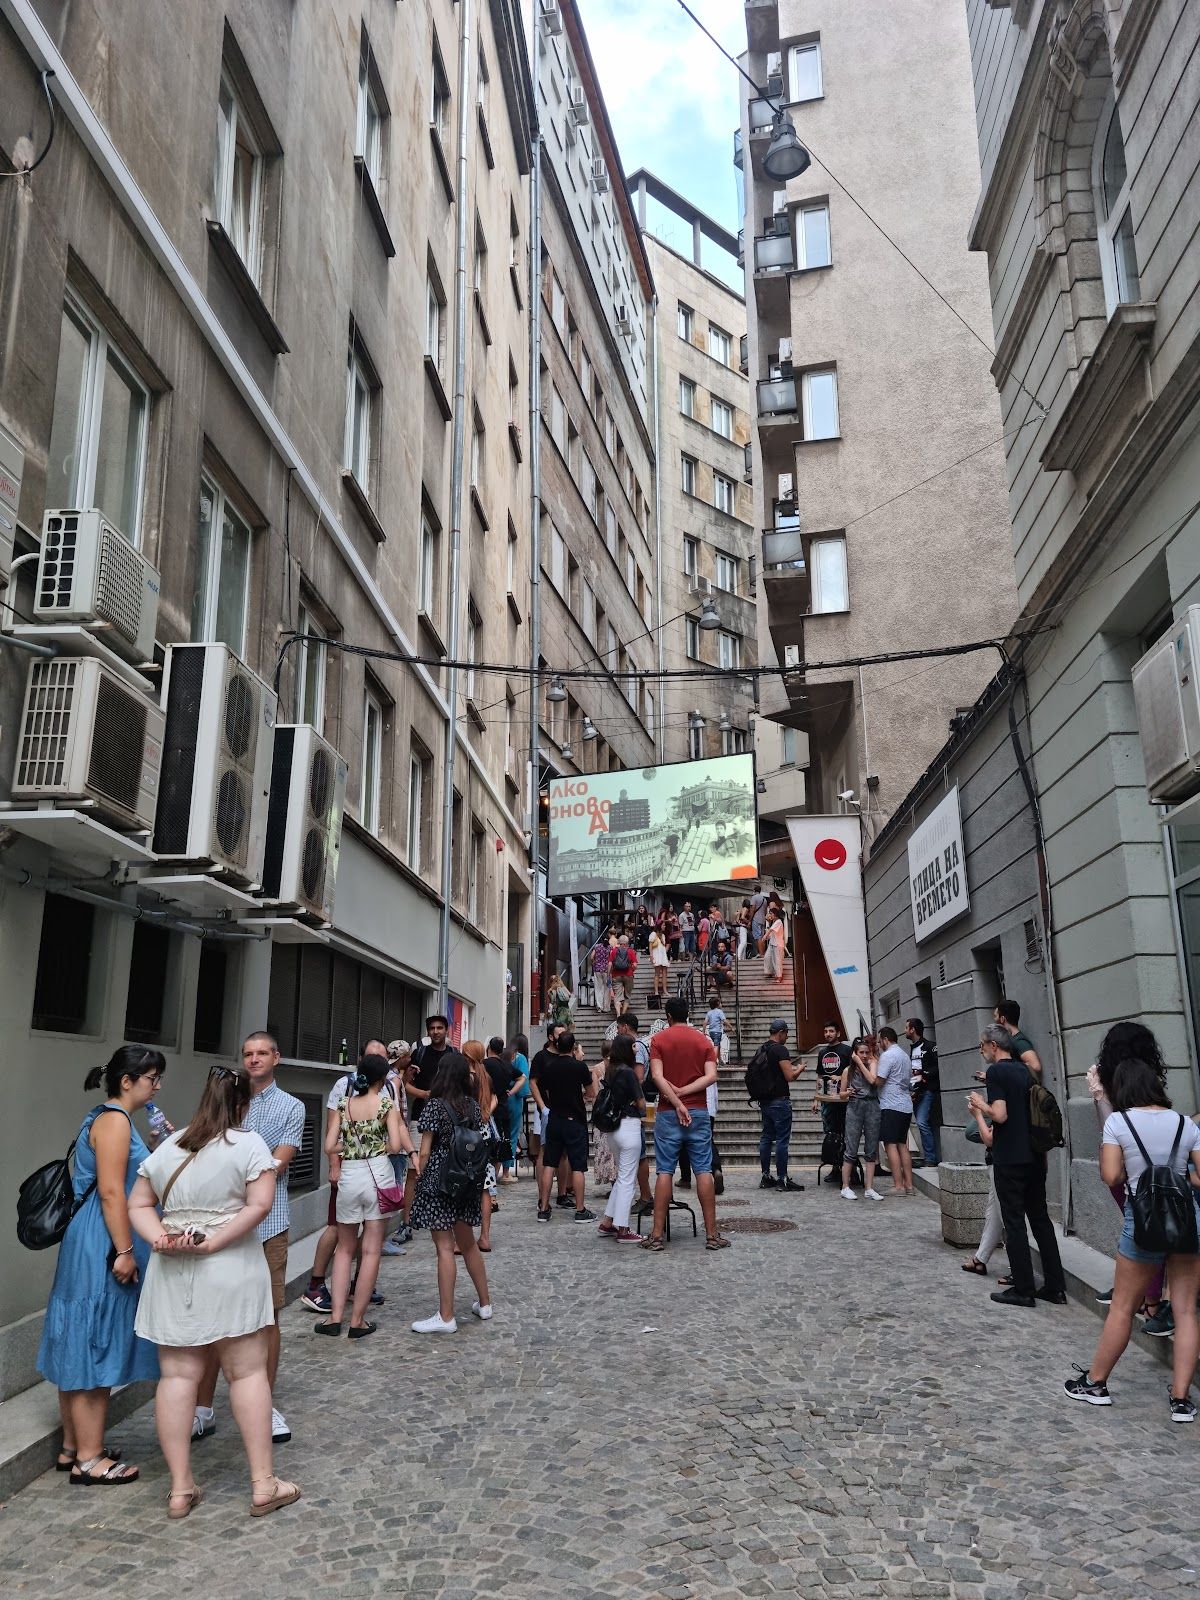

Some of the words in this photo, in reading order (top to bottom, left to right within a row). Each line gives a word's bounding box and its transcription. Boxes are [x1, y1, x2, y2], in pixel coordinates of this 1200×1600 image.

[912, 856, 942, 901] УЛИЦА
[943, 840, 960, 875] НА
[916, 871, 960, 926] ВРЕМЕТО
